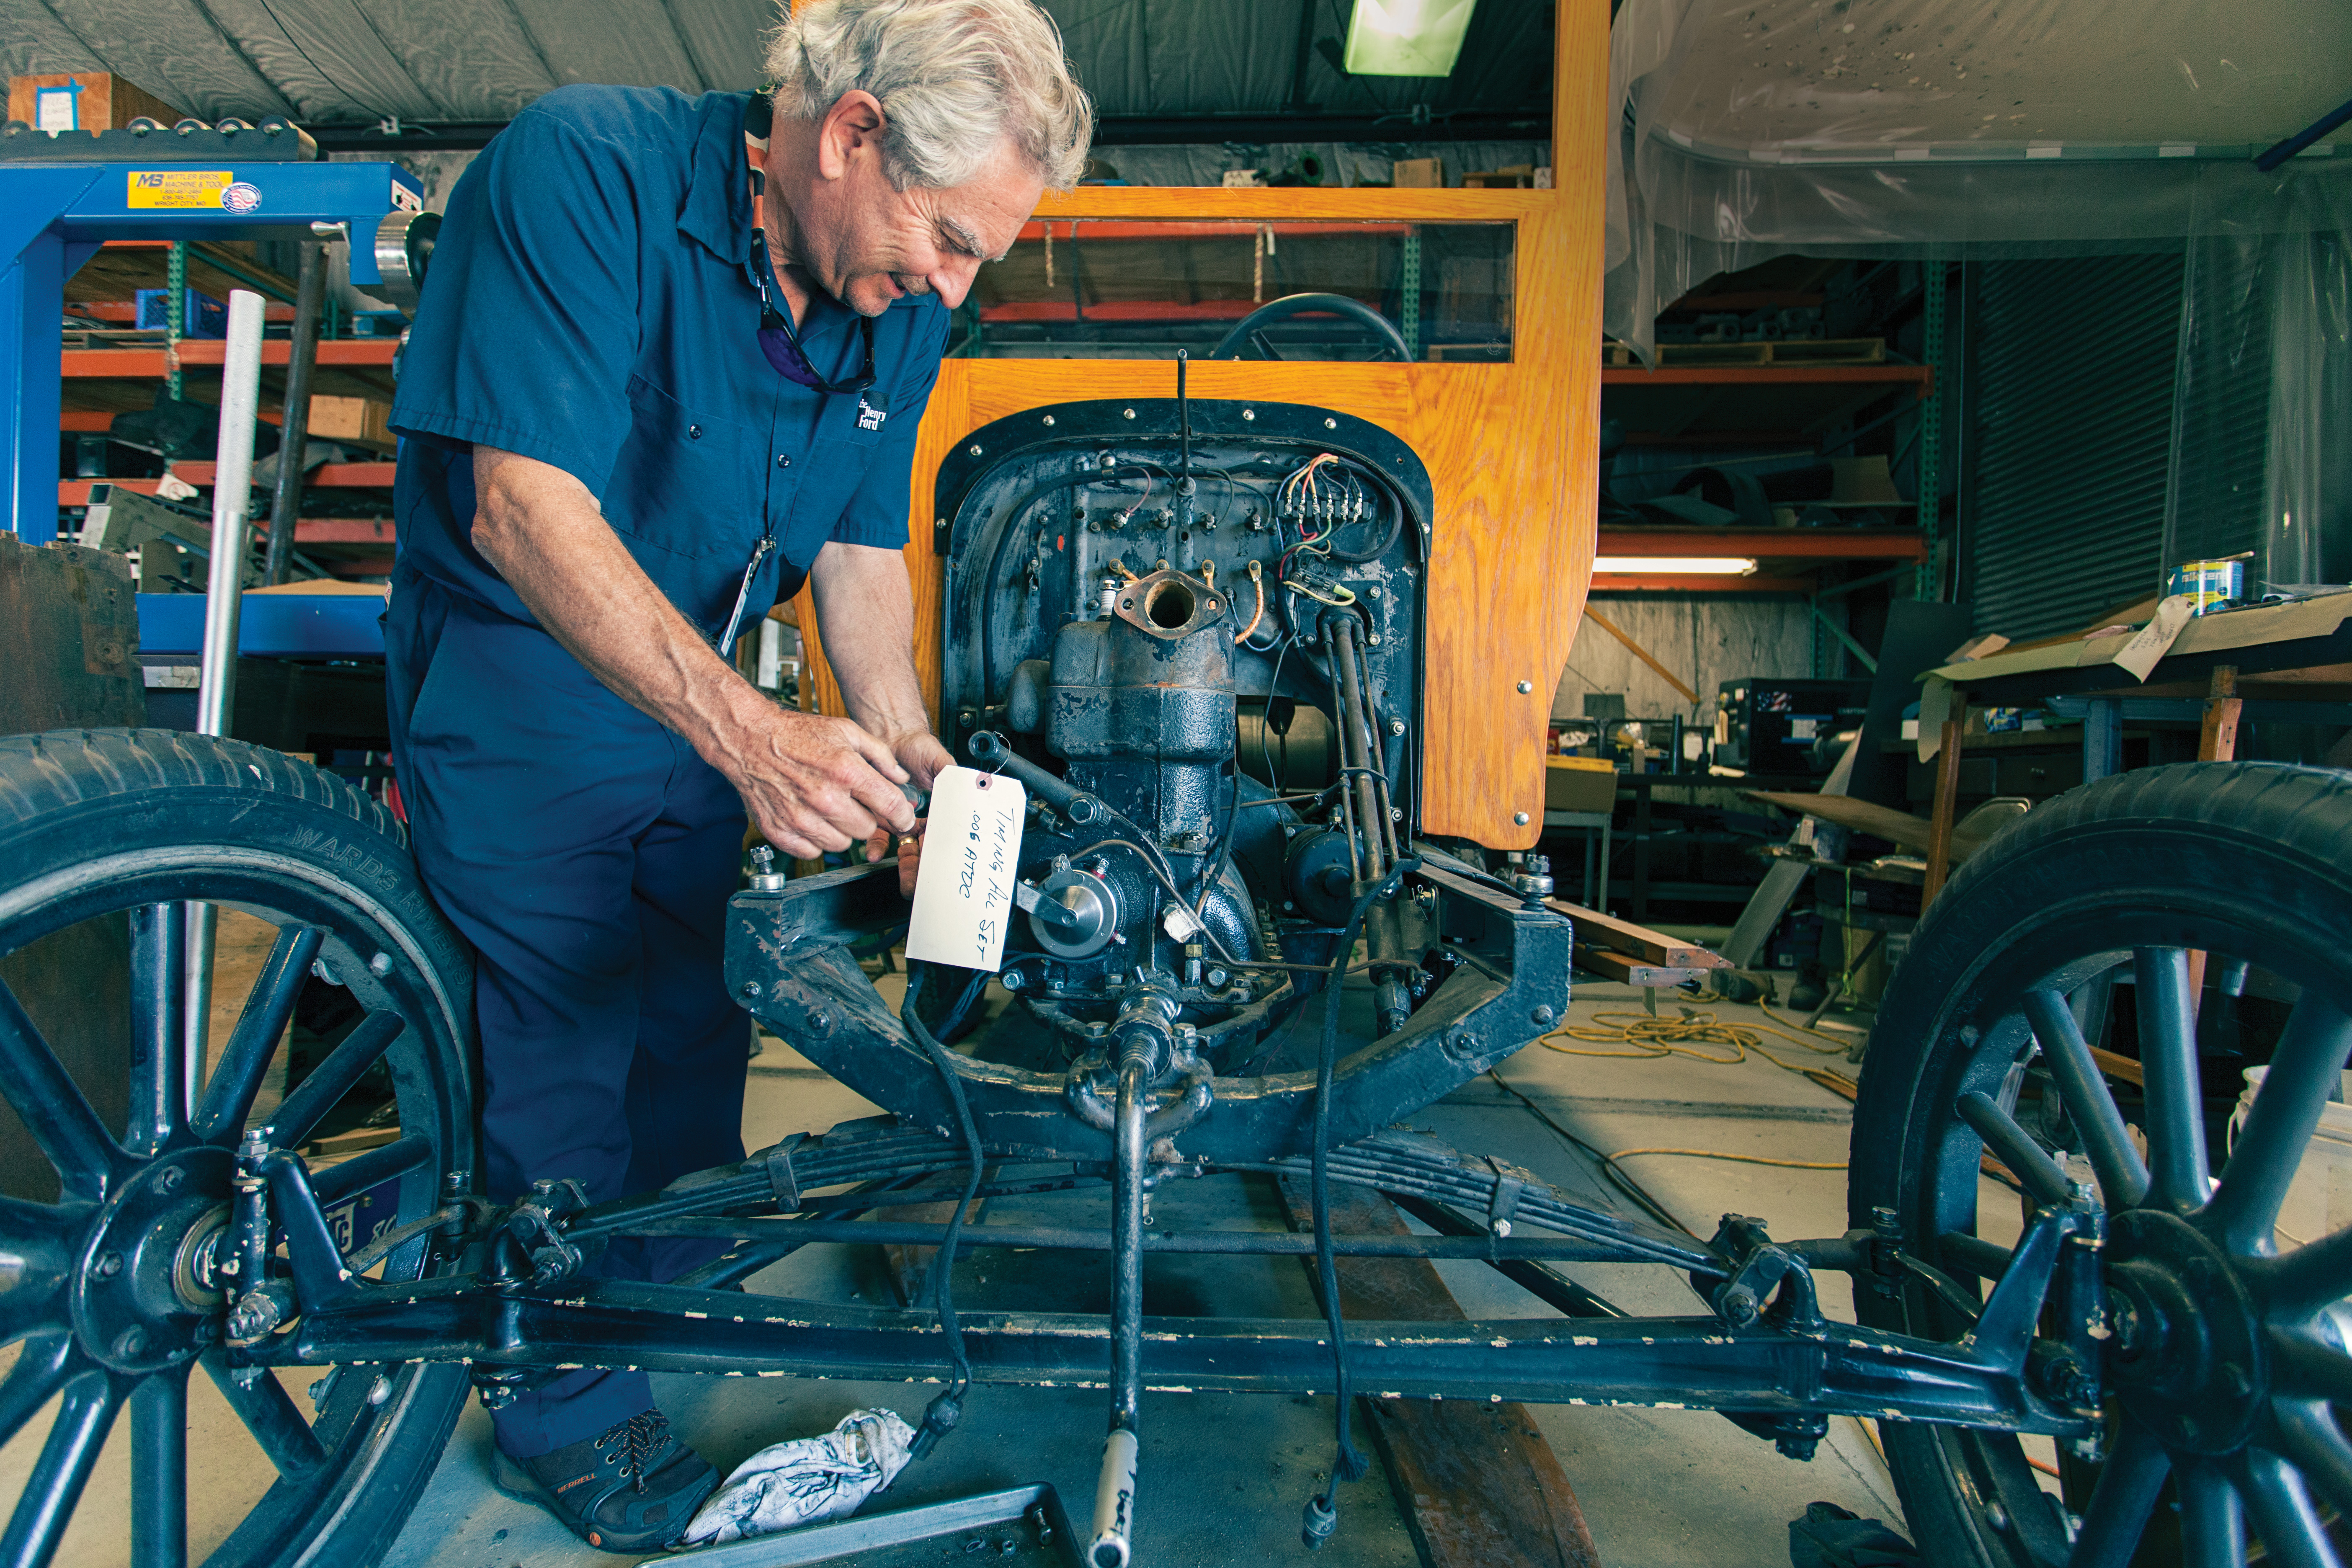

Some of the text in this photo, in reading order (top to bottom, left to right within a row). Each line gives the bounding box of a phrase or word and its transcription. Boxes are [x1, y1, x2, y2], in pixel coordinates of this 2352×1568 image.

[859, 414, 879, 431] Ford
[865, 406, 887, 422] Henry
[293, 824, 401, 891] WARDS
[977, 808, 1015, 962] TIMING ALL SET
[557, 1473, 597, 1494] MERRELL
